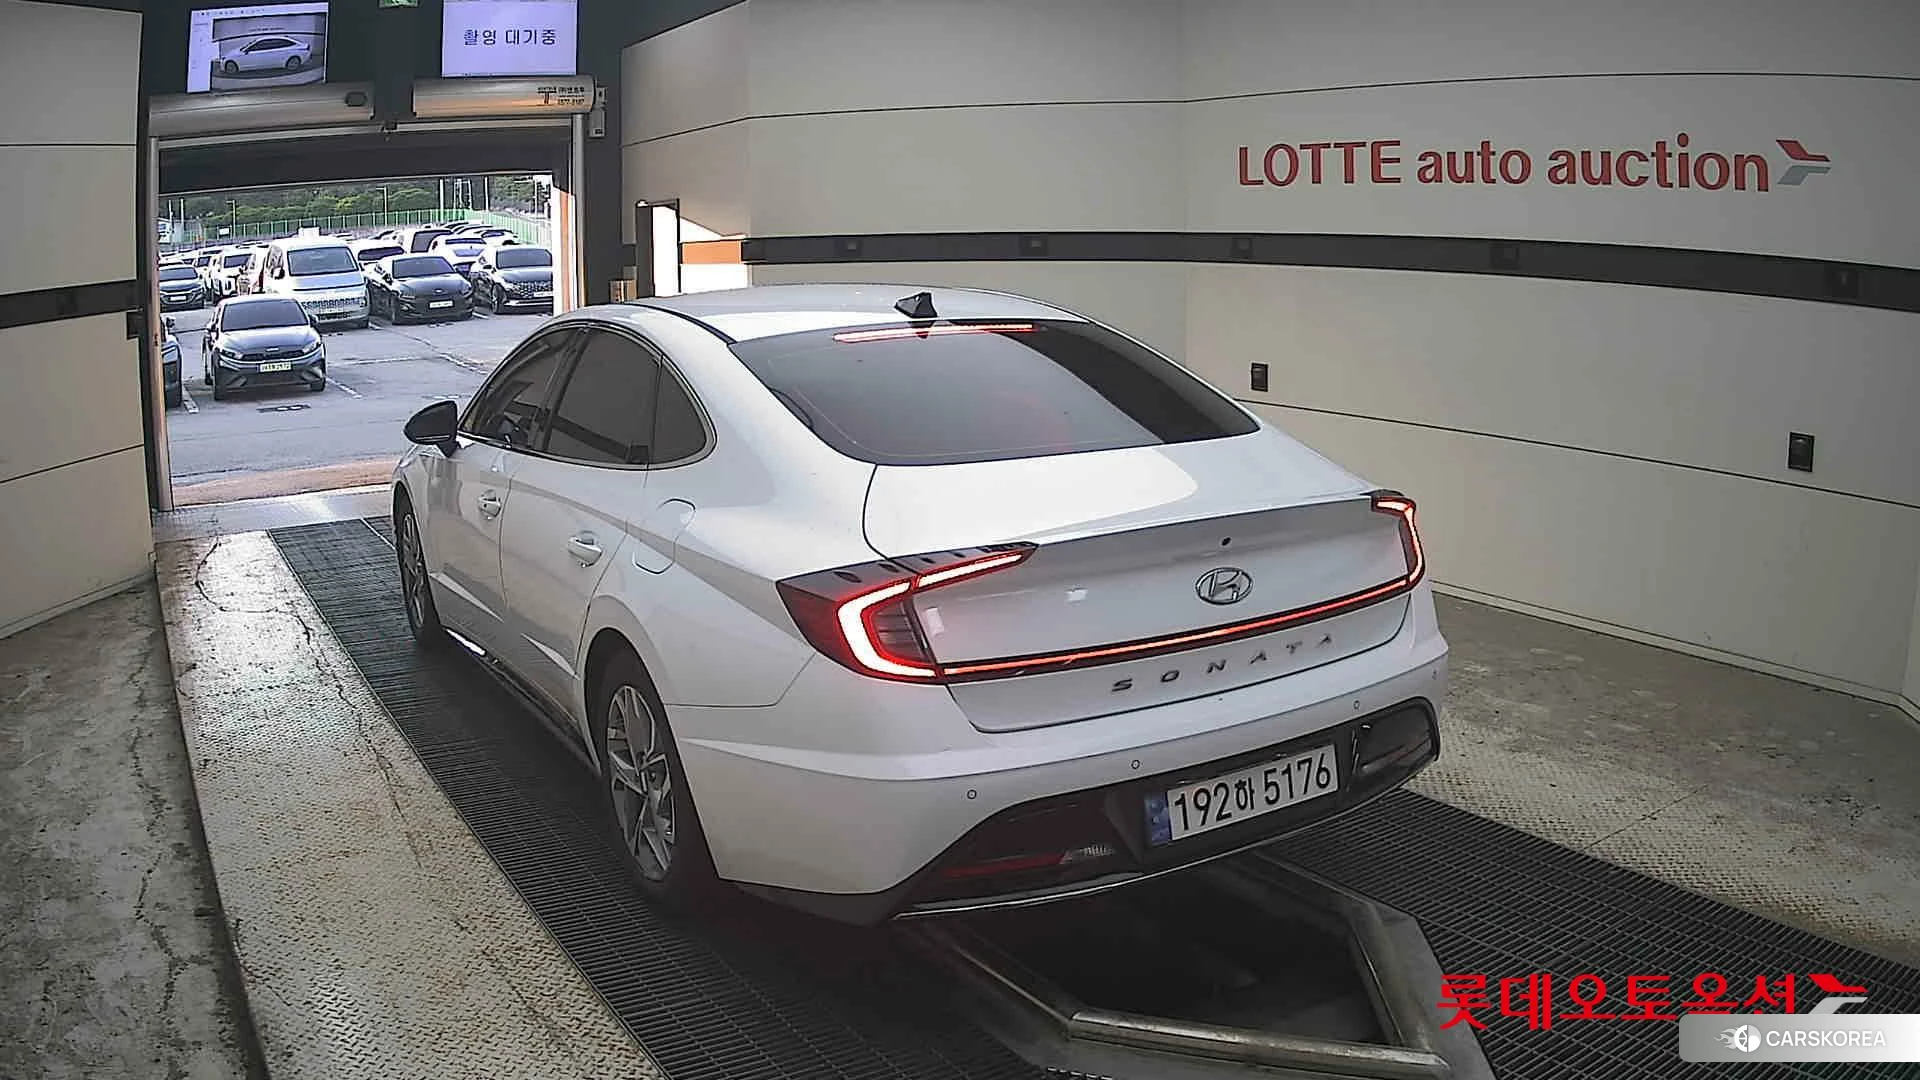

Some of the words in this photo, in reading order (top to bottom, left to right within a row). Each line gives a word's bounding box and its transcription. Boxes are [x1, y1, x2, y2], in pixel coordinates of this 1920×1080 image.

[464, 29, 497, 45] 촬영
[505, 29, 557, 45] 대기중
[1238, 140, 1401, 186] LOTTE
[1416, 140, 1532, 184] auto
[1547, 133, 1769, 192] auction
[1111, 634, 1333, 692] SONATA
[1174, 777, 1255, 831] 192하
[1262, 753, 1331, 806] 5176
